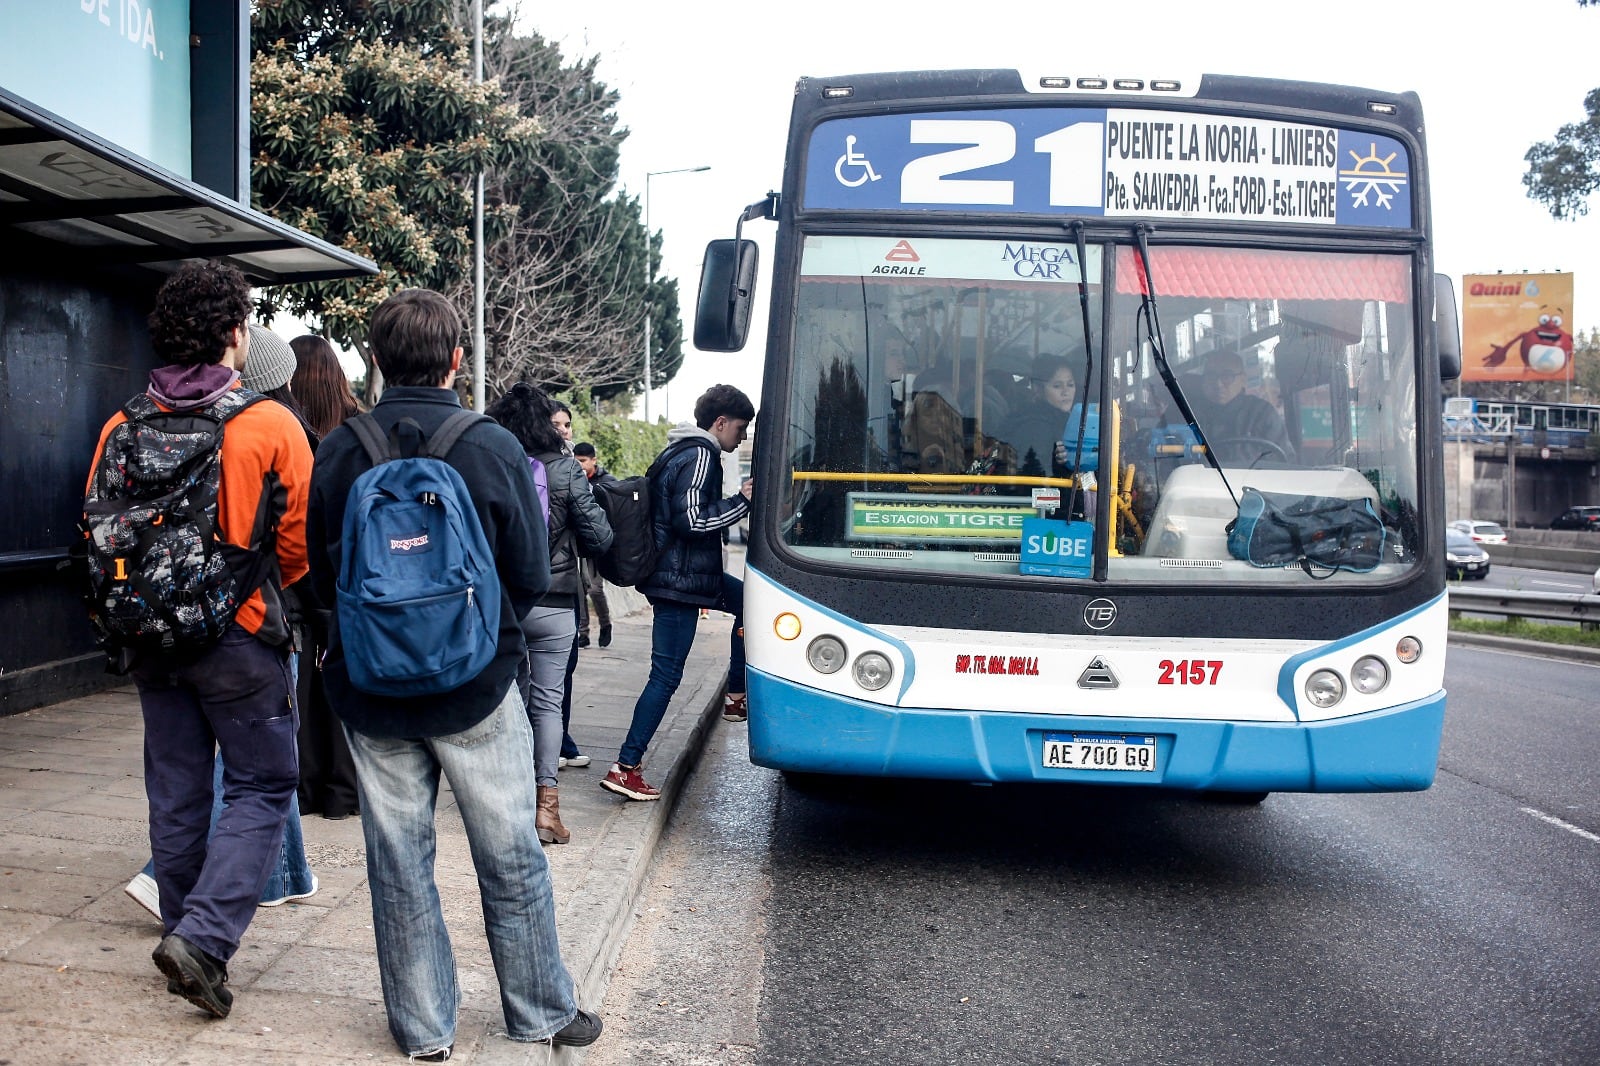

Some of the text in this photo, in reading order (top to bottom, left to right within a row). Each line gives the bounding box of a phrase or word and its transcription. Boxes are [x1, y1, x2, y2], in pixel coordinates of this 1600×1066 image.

[1107, 121, 1174, 160] PUENTE
[1179, 123, 1200, 161] LA
[1271, 127, 1336, 168] LINIERS
[900, 119, 1104, 207] 21
[1106, 171, 1129, 210] Pte.
[1132, 171, 1200, 212] SAAVEDRA
[1001, 242, 1075, 264] MEGA
[871, 265, 927, 276] AGRALE
[1013, 259, 1063, 279] CAR
[1470, 280, 1540, 298] Quini 6
[944, 514, 1023, 527] TIGRE
[1027, 535, 1087, 558] SUBE
[1157, 659, 1224, 685] 2157
[1049, 744, 1149, 767] AE 700 GQ
